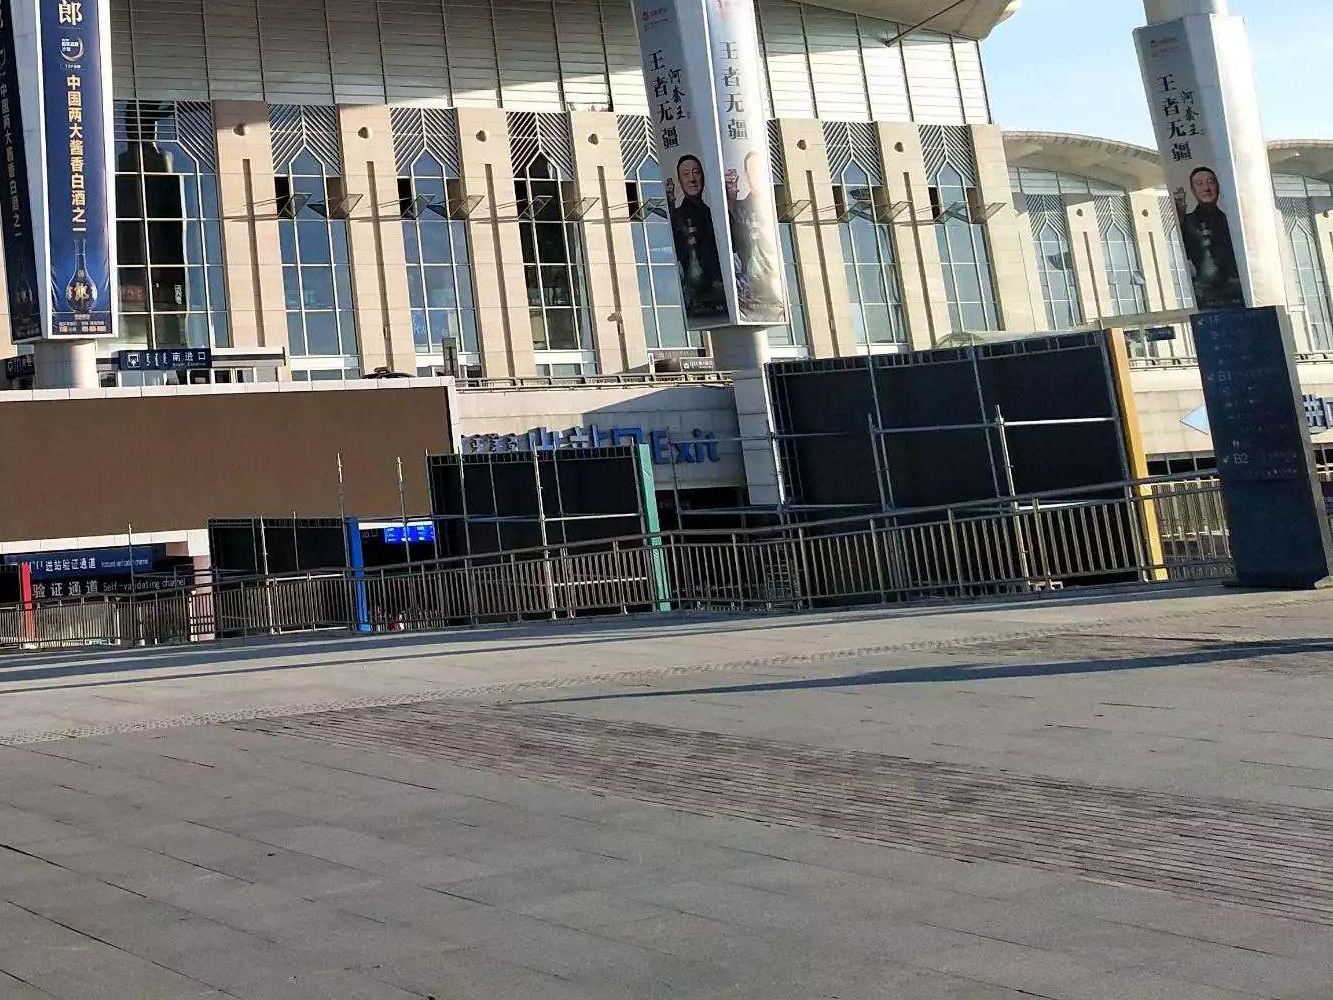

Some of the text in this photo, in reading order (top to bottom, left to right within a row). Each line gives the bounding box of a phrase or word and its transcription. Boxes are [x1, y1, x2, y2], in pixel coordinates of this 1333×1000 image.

[649, 50, 680, 149] 王者无疆
[718, 41, 748, 140] 王者无疆
[1157, 74, 1193, 161] 王者无疆
[66, 74, 86, 232] 中国两大酱香白酒之一
[650, 428, 721, 465] Exit
[32, 580, 99, 599] 验证通道
[45, 557, 96, 572] 进站验证通道
